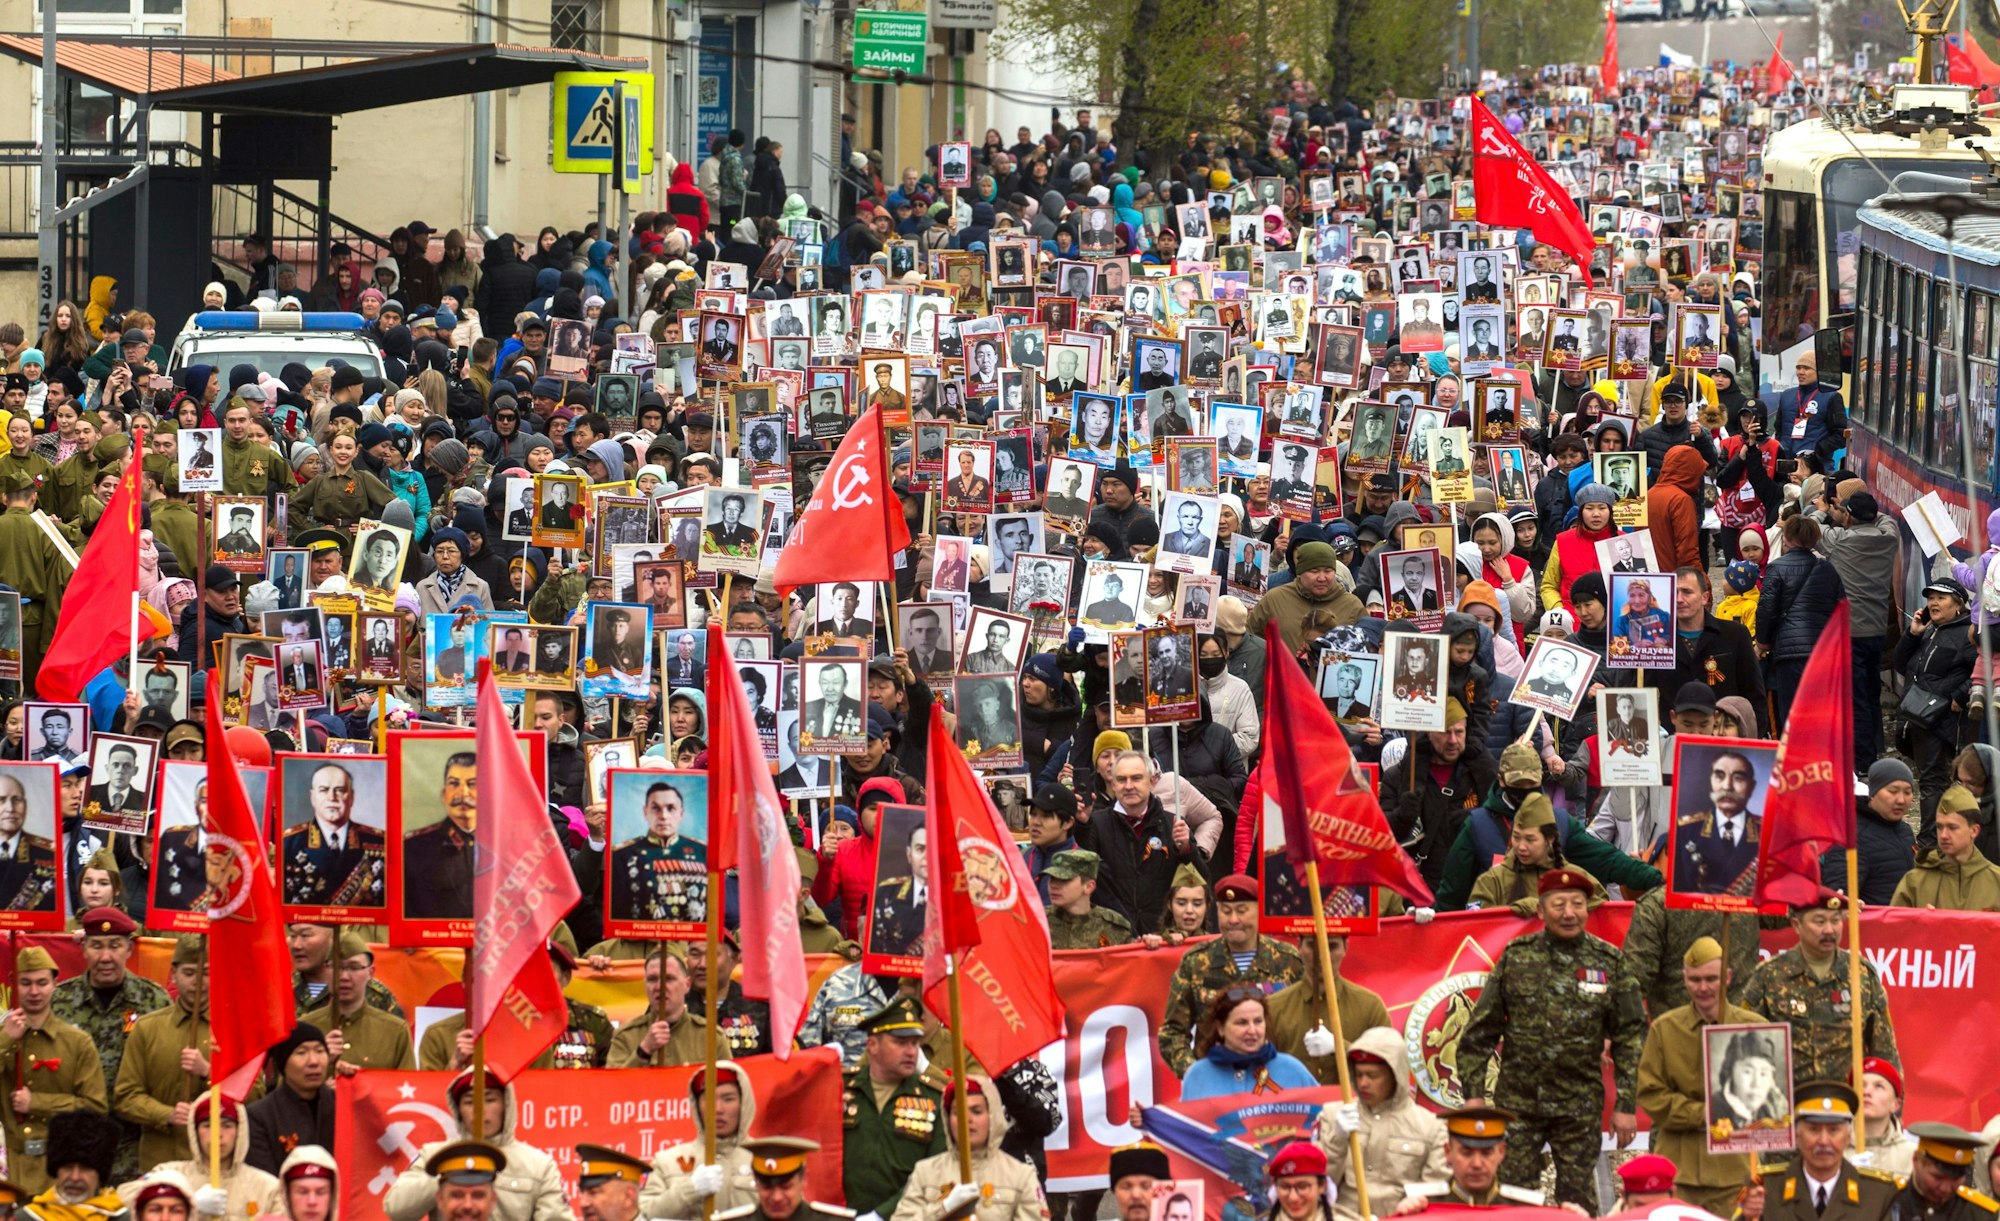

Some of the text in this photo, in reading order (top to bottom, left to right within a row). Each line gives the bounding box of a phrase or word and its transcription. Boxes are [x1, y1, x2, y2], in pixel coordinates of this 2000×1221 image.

[863, 49, 916, 63] ЗАЙМЫ
[41, 265, 53, 320] 334
[962, 502, 991, 510] 1941-1945
[1630, 646, 1673, 656] Зундуева
[966, 961, 1026, 1035] ПОЛК
[610, 1097, 692, 1125] ОРДЕНА
